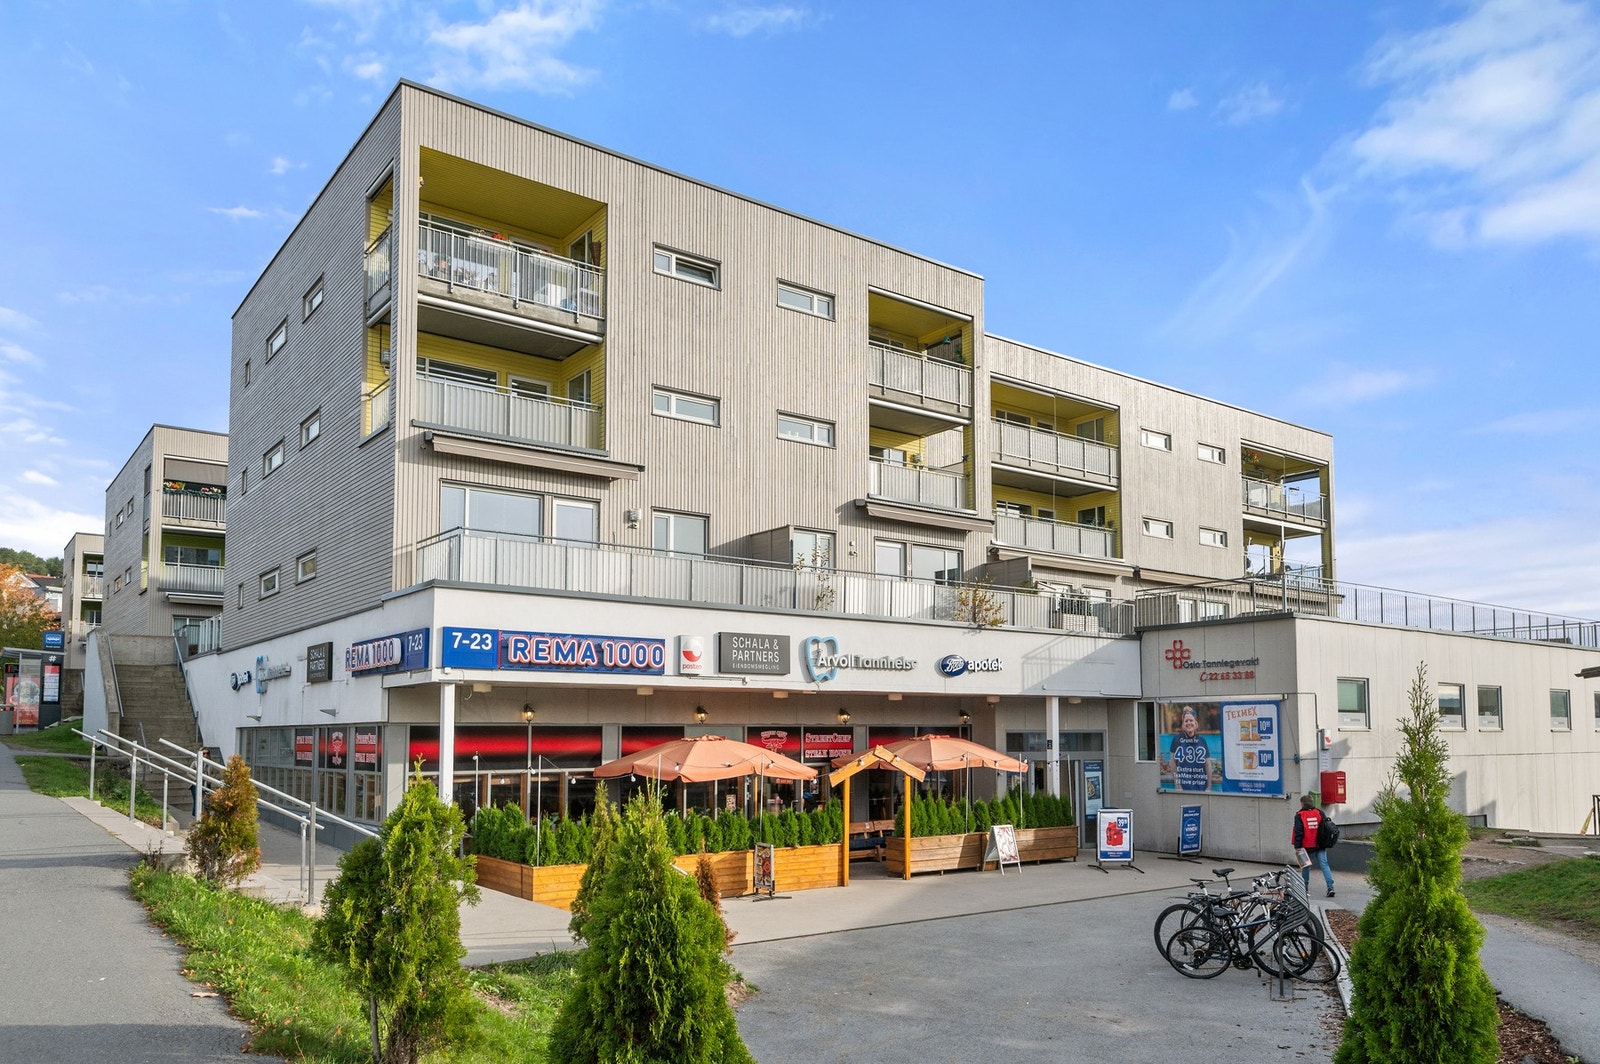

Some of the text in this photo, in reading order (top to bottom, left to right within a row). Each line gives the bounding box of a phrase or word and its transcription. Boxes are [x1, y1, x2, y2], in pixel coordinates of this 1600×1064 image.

[408, 634, 424, 652] 7-23
[452, 632, 492, 650] 7-23
[732, 636, 779, 650] SCHALA &
[345, 638, 395, 672] REMA 1000
[508, 635, 665, 668] REMA 1000
[732, 650, 780, 663] PARTNERS
[967, 658, 1003, 672] apotek
[1183, 661, 1200, 669] Oslo
[1209, 672, 1218, 680] 22
[1225, 706, 1258, 720] TEXMEX
[1174, 746, 1207, 764] 432
